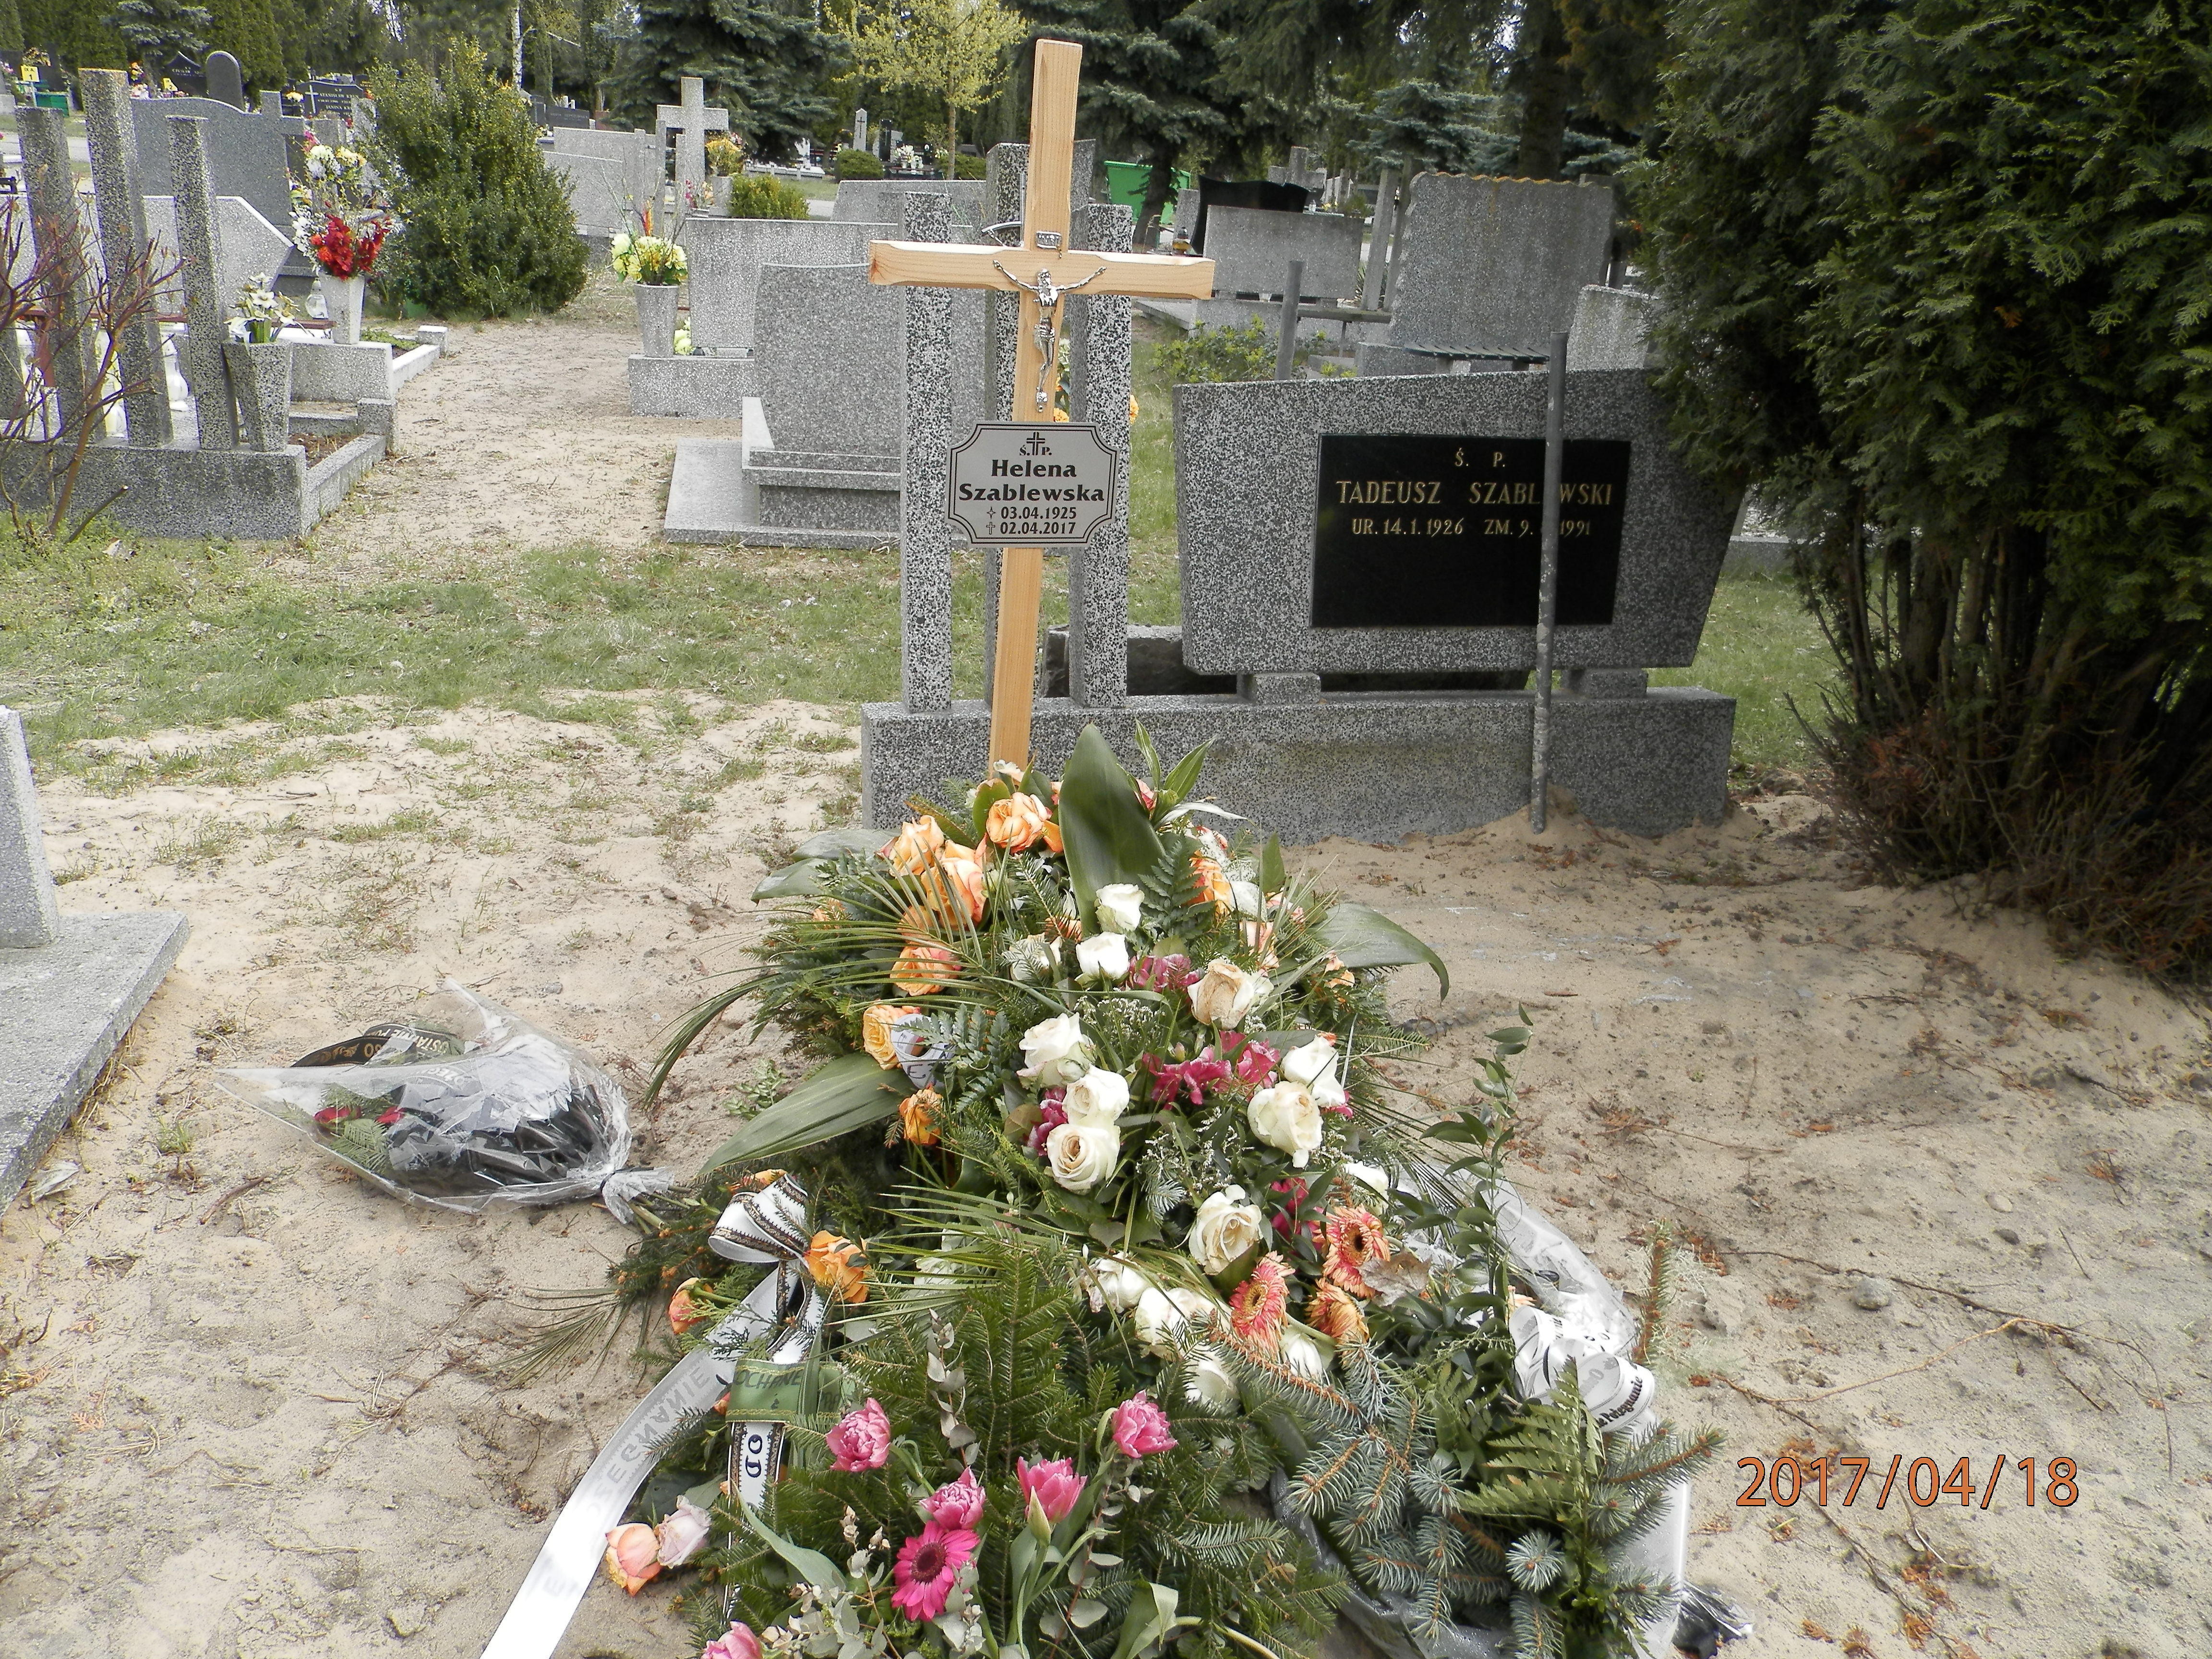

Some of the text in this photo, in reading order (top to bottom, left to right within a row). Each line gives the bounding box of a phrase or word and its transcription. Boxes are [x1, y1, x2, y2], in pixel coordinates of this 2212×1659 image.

[1042, 447, 1052, 456] P.
[1493, 452, 1505, 467] P.
[991, 459, 1077, 477] Helena
[959, 483, 1104, 501] Szablewska
[1336, 481, 1612, 505] TADEUSZ SZABLWSKI
[1001, 506, 1076, 519] 03.04.1925
[1000, 522, 1076, 535] 02.04.2017
[1352, 518, 1378, 535] UR.
[1484, 519, 1513, 535] ZM.
